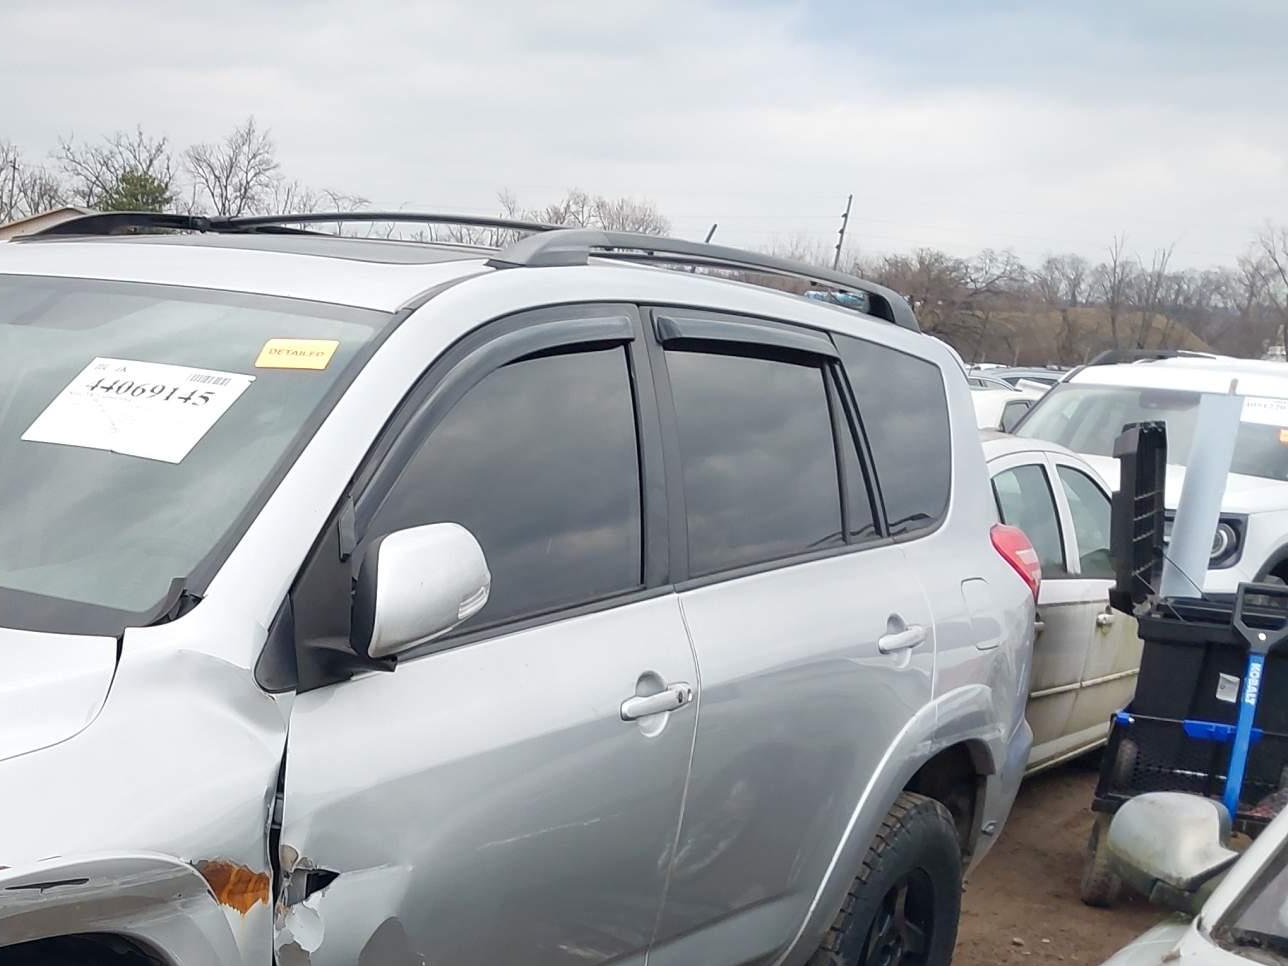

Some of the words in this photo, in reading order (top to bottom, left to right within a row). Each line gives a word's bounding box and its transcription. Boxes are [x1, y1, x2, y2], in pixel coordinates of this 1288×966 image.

[268, 348, 326, 357] DETAILED
[85, 377, 216, 406] 44069145
[1245, 662, 1262, 705] KOBALT
